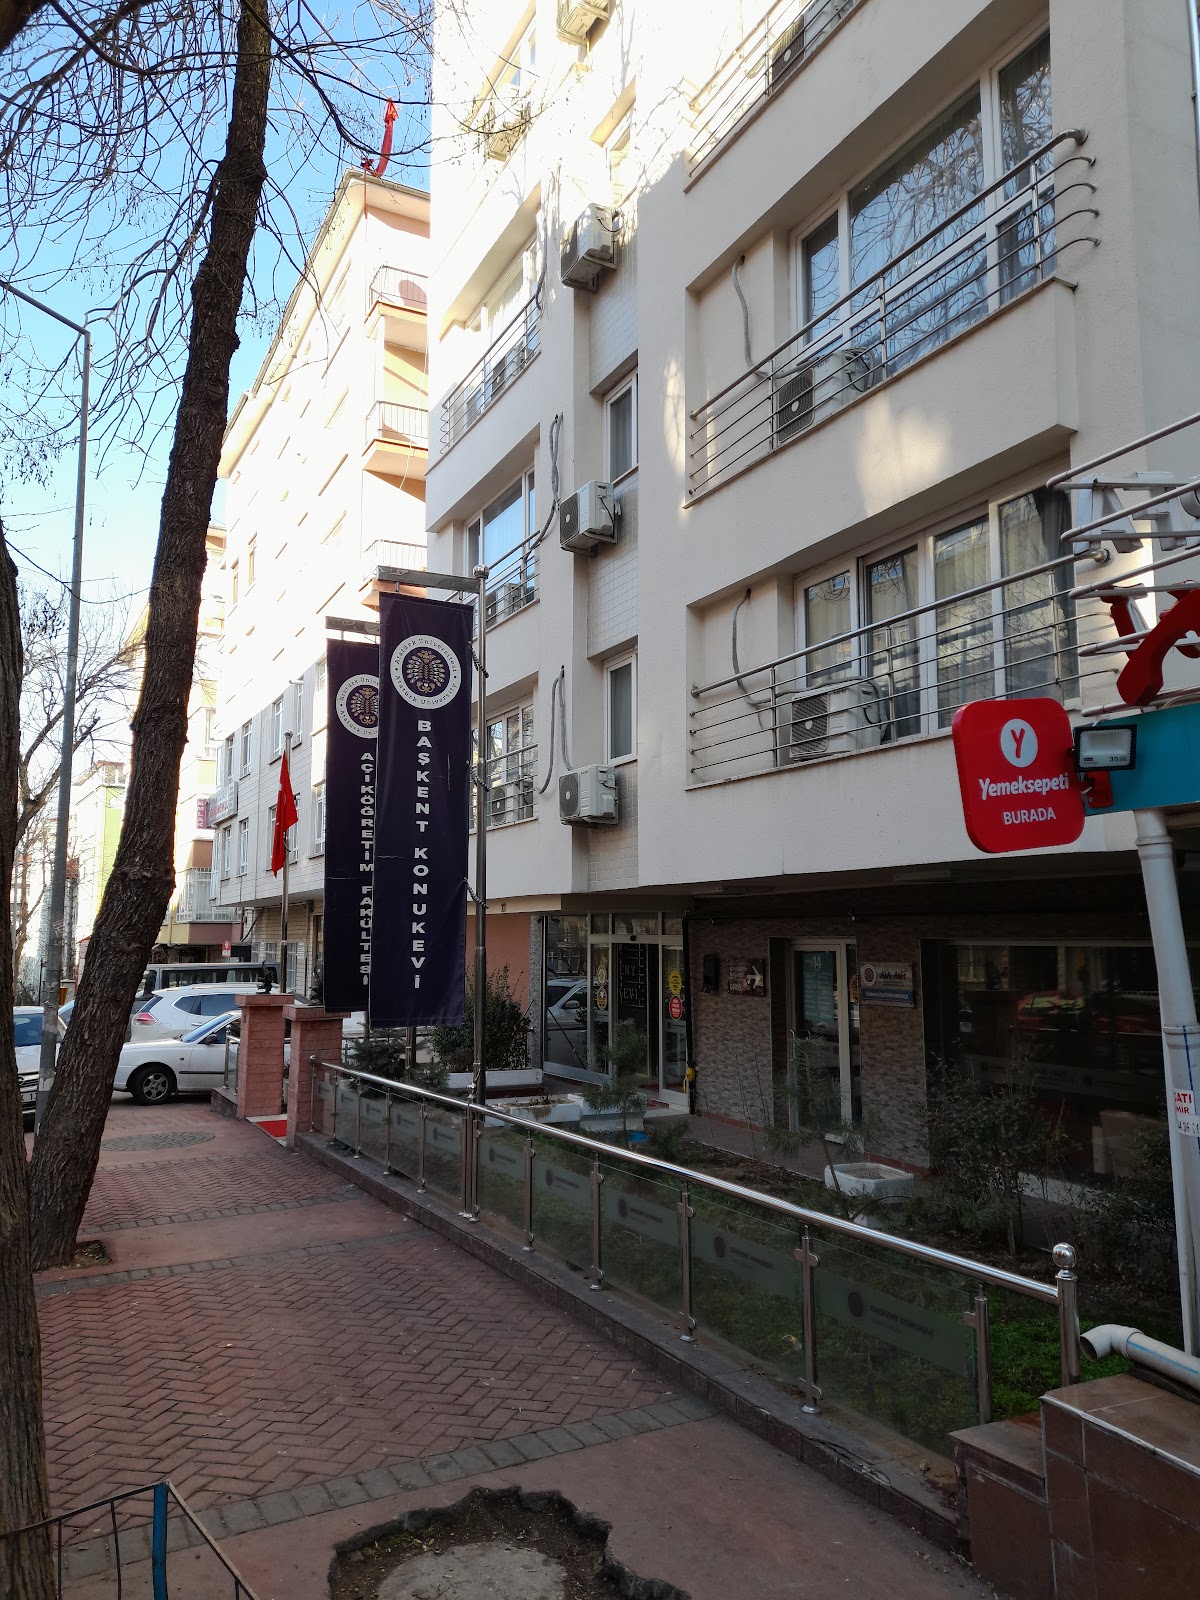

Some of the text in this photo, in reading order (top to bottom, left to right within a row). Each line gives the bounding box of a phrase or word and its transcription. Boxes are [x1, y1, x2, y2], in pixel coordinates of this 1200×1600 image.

[1010, 728, 1026, 759] Y
[978, 772, 1069, 800] Yemeksepeti
[1003, 807, 1056, 825] BURADA
[410, 719, 432, 989] BAŞKENT KONUKEVİ
[360, 885, 373, 986] FAKÜLTESİ
